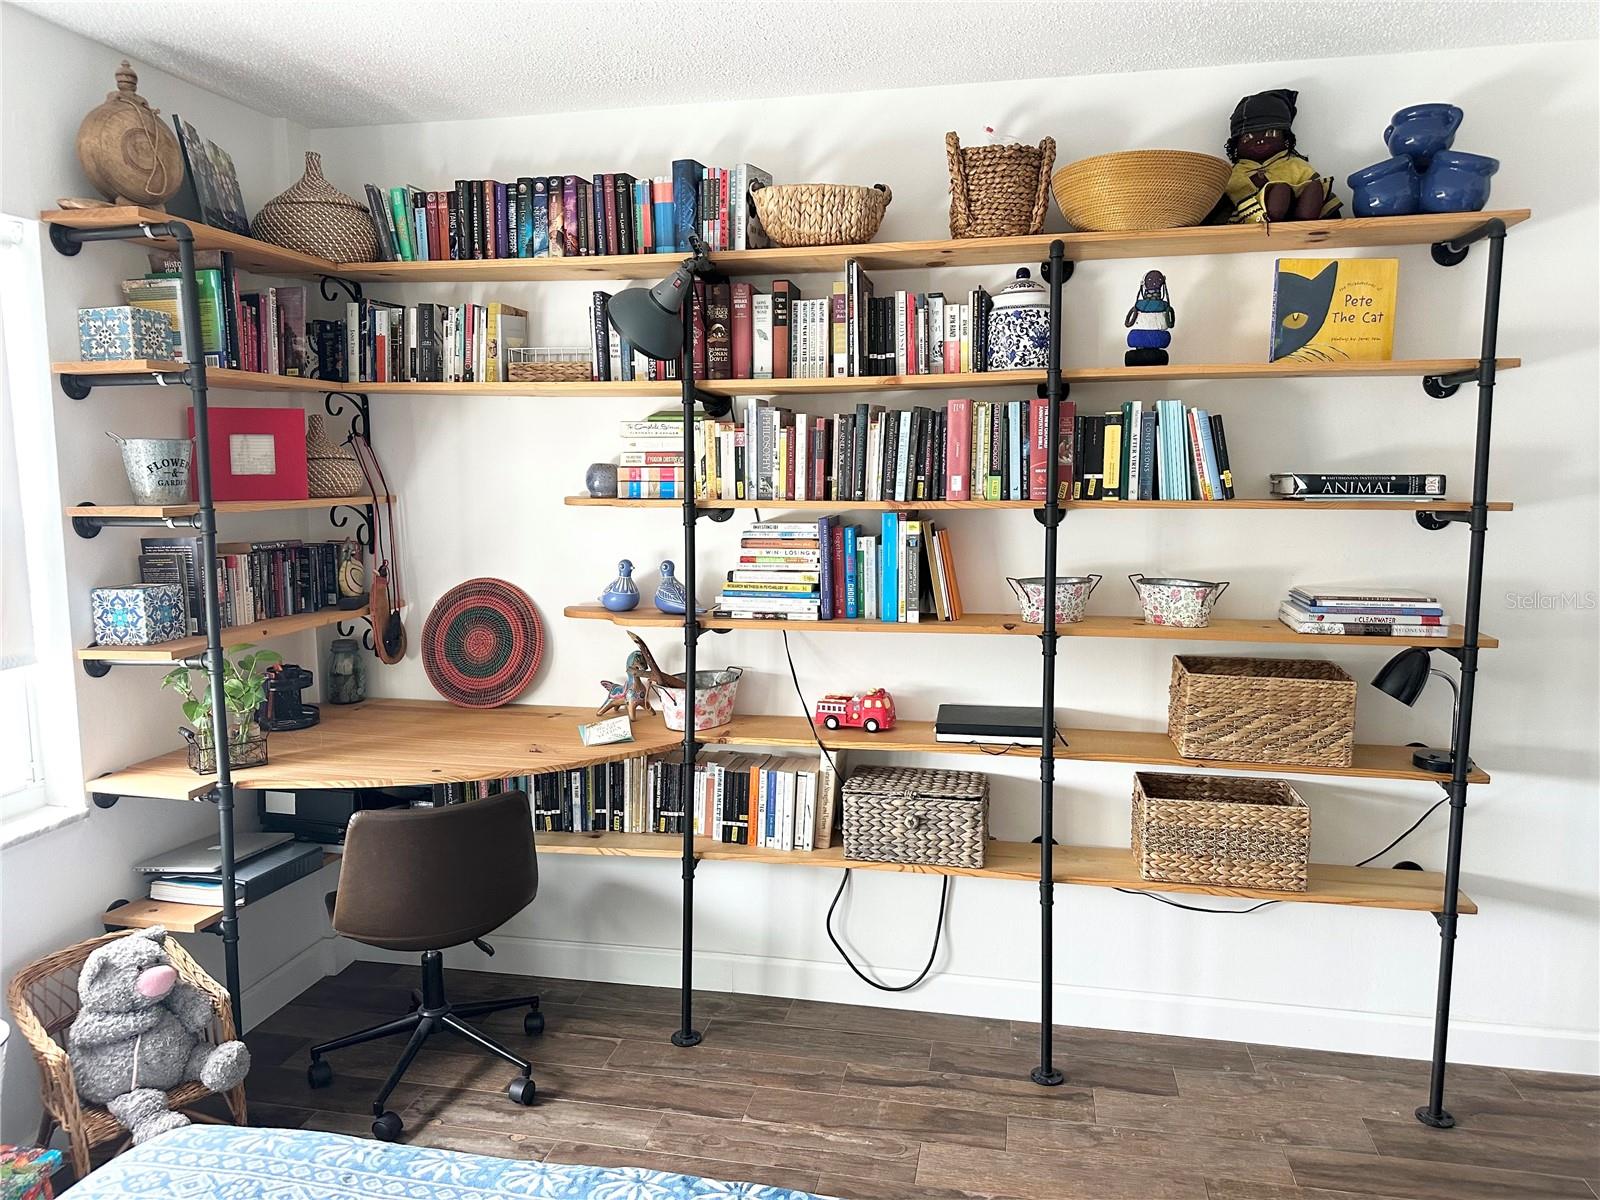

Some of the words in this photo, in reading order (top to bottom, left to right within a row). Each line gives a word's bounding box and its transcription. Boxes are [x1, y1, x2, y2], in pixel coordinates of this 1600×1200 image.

[1344, 294, 1373, 307] Pete
[1332, 312, 1355, 323] The
[1362, 312, 1384, 323] Cat
[762, 417, 770, 470] PHILOSOPHY
[1322, 482, 1394, 494] ANIMAL
